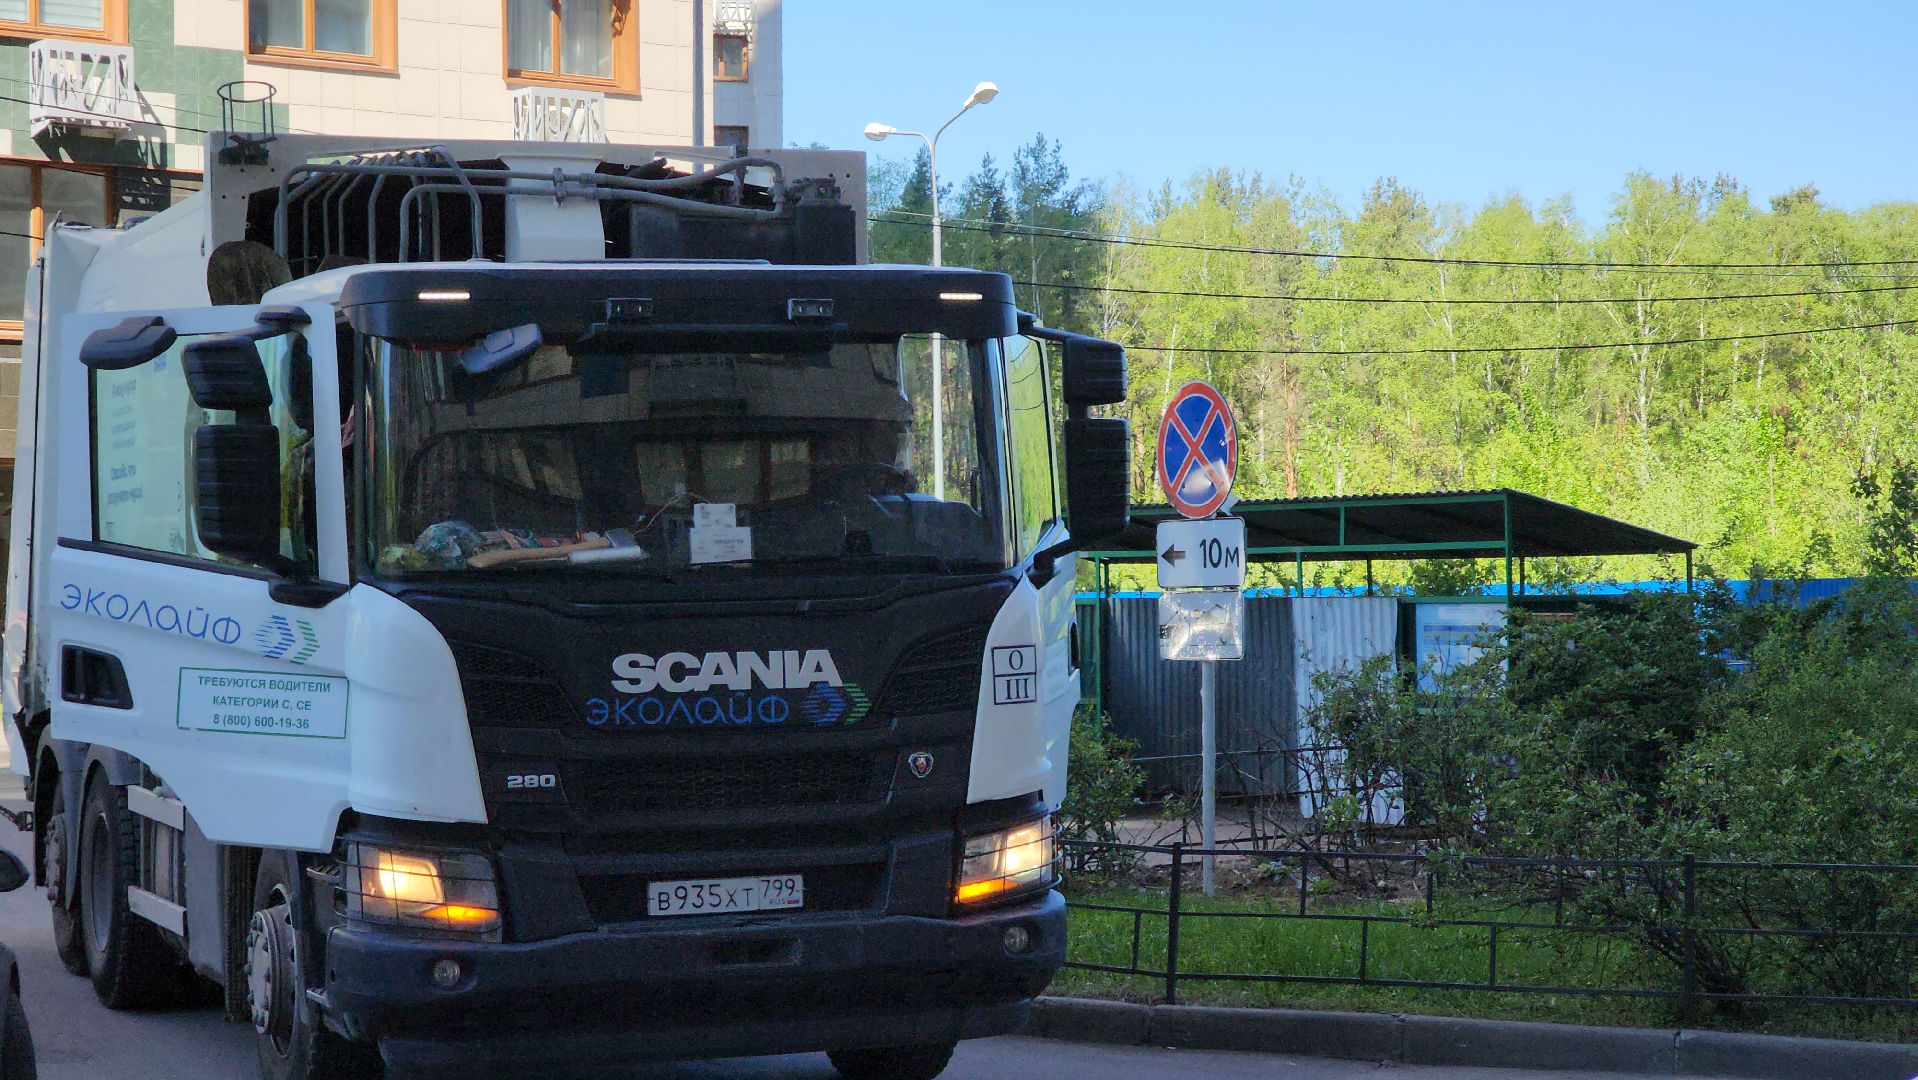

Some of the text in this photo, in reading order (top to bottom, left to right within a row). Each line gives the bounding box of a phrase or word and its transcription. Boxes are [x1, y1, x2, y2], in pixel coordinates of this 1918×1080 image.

[611, 649, 843, 694] SCANIA
[198, 676, 331, 693] ТРЕБУЮТСЯ ВОДИТЕЛИ
[213, 696, 279, 709] КАТЕГОРИИ
[296, 701, 312, 711] СЕ
[213, 714, 309, 729] 8 (800) 600-19-36
[507, 774, 556, 788] 280
[761, 878, 796, 897] 799
